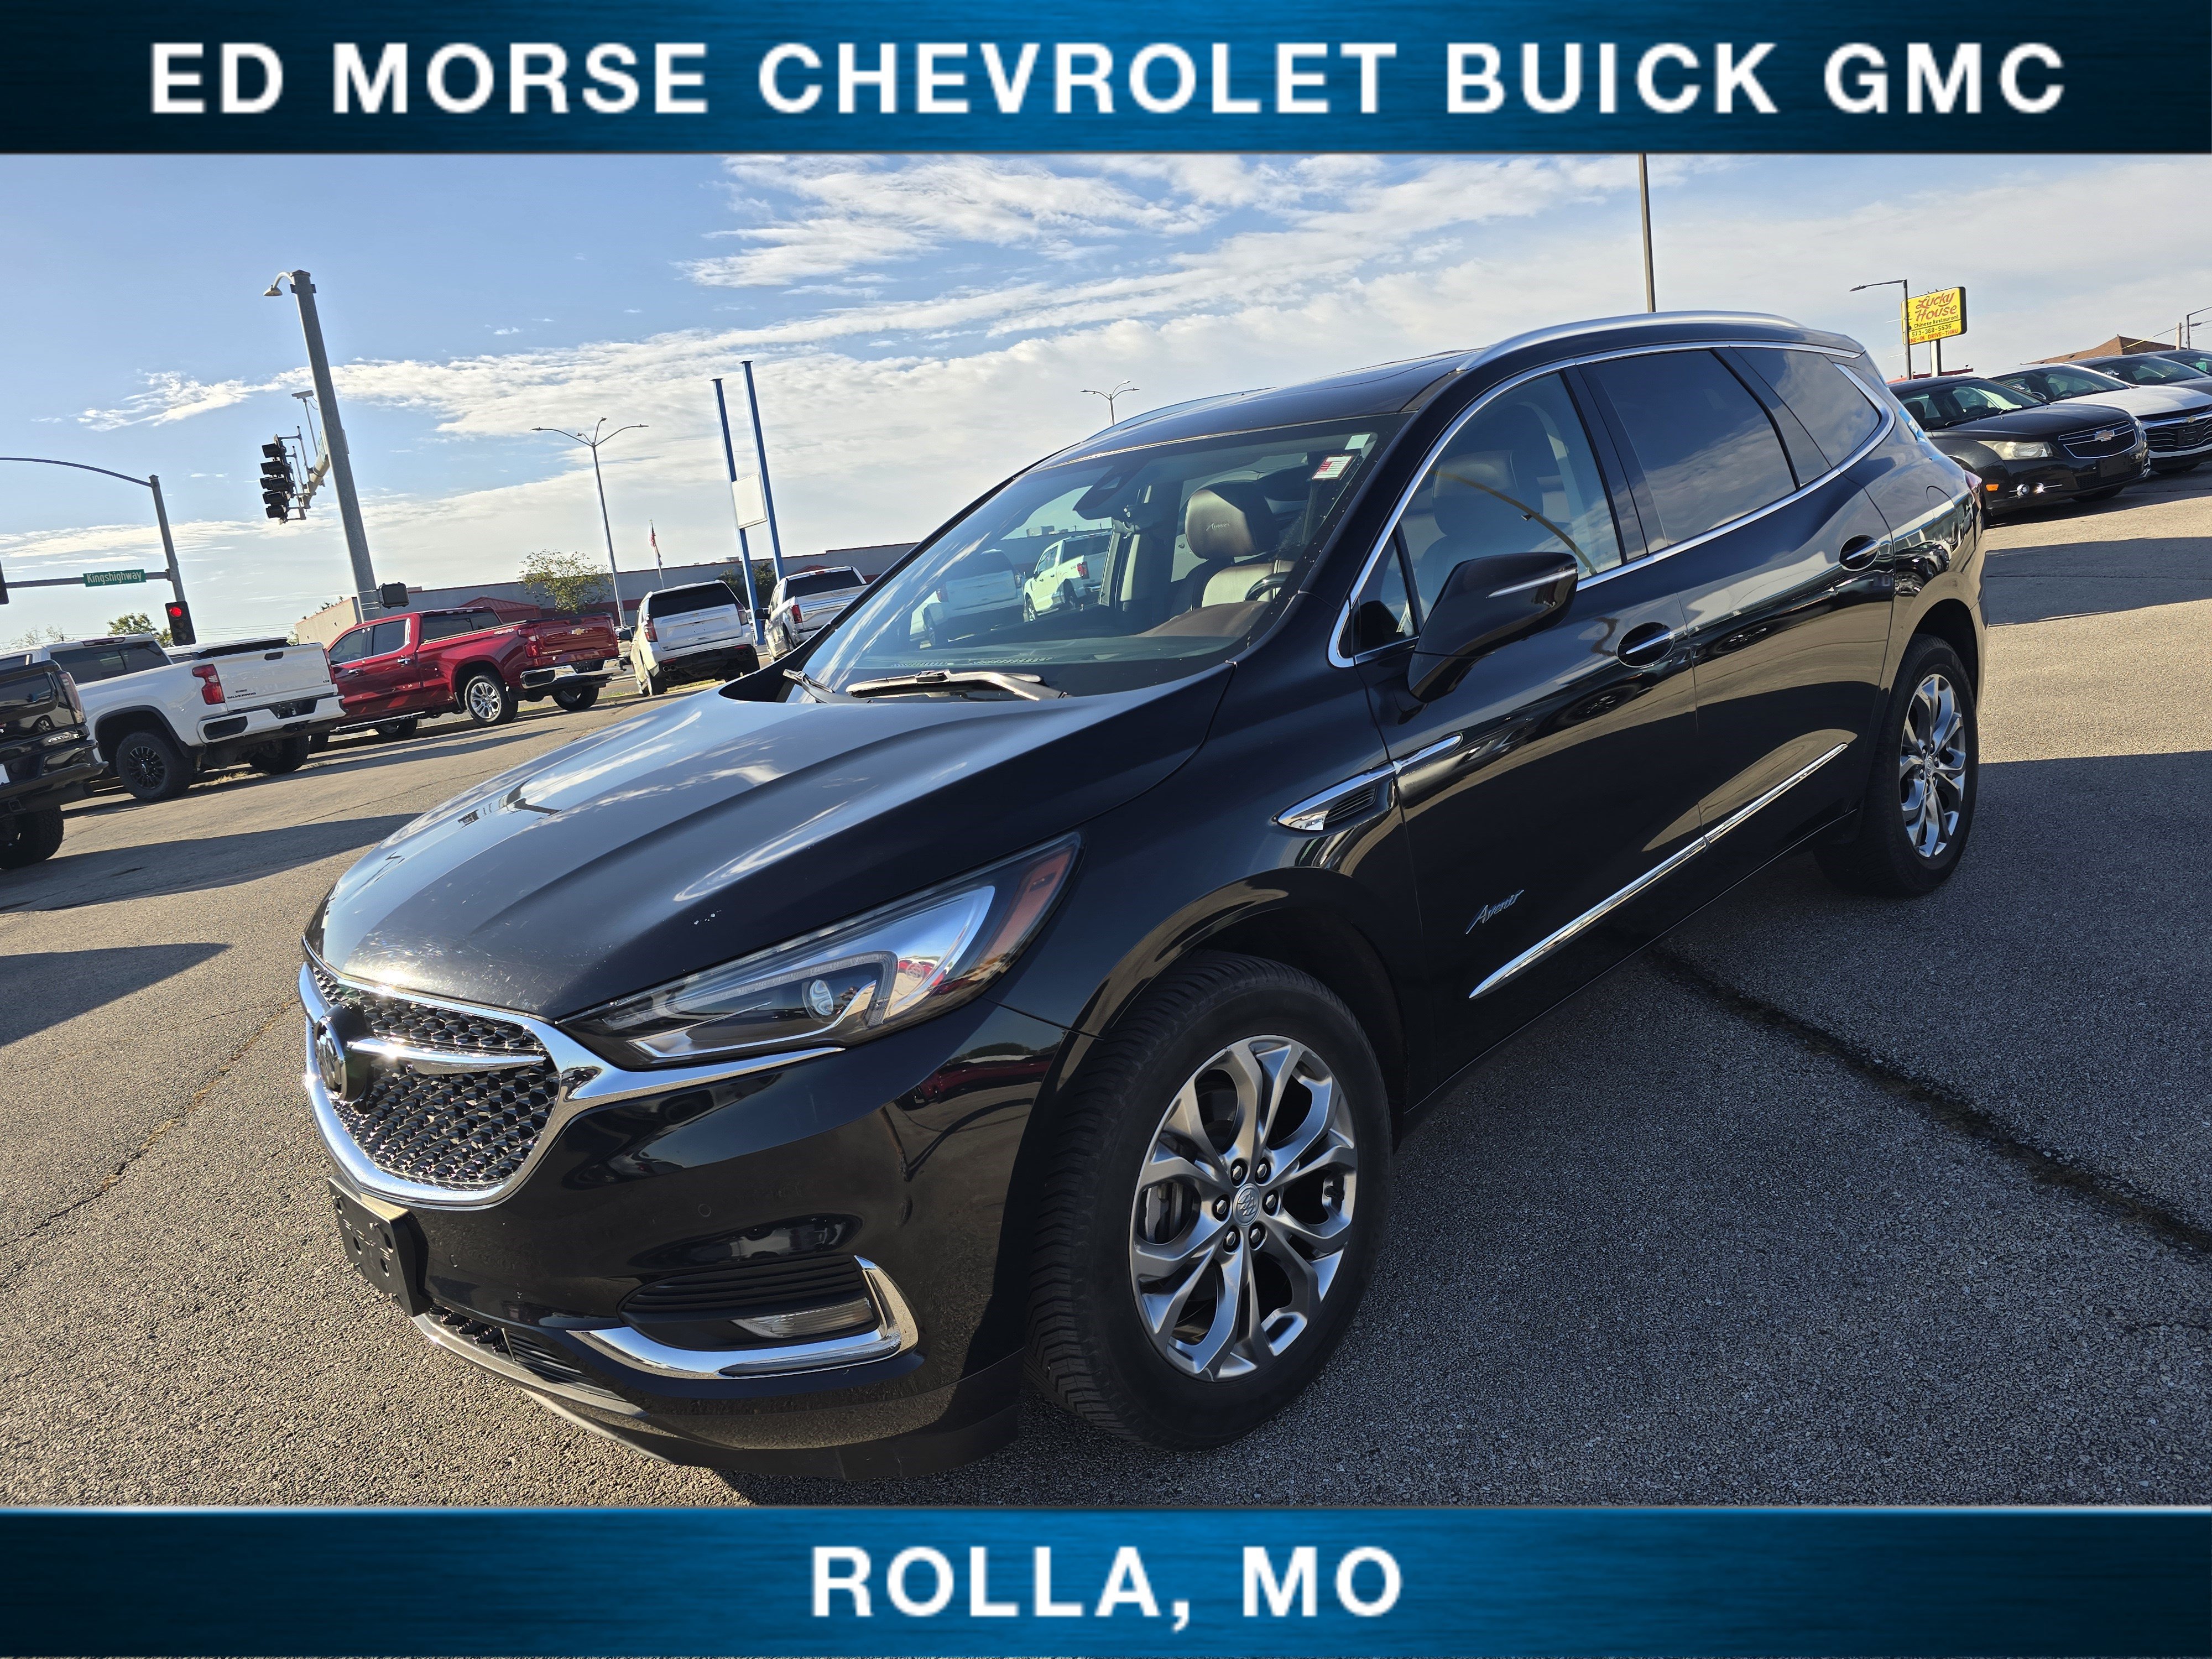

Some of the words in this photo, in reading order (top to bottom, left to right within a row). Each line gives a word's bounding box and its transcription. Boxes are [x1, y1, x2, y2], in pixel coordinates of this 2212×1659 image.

[1933, 314, 1959, 325] Restaurant
[1912, 324, 1952, 337] 573-368-5535
[86, 571, 142, 585] Kingshighway
